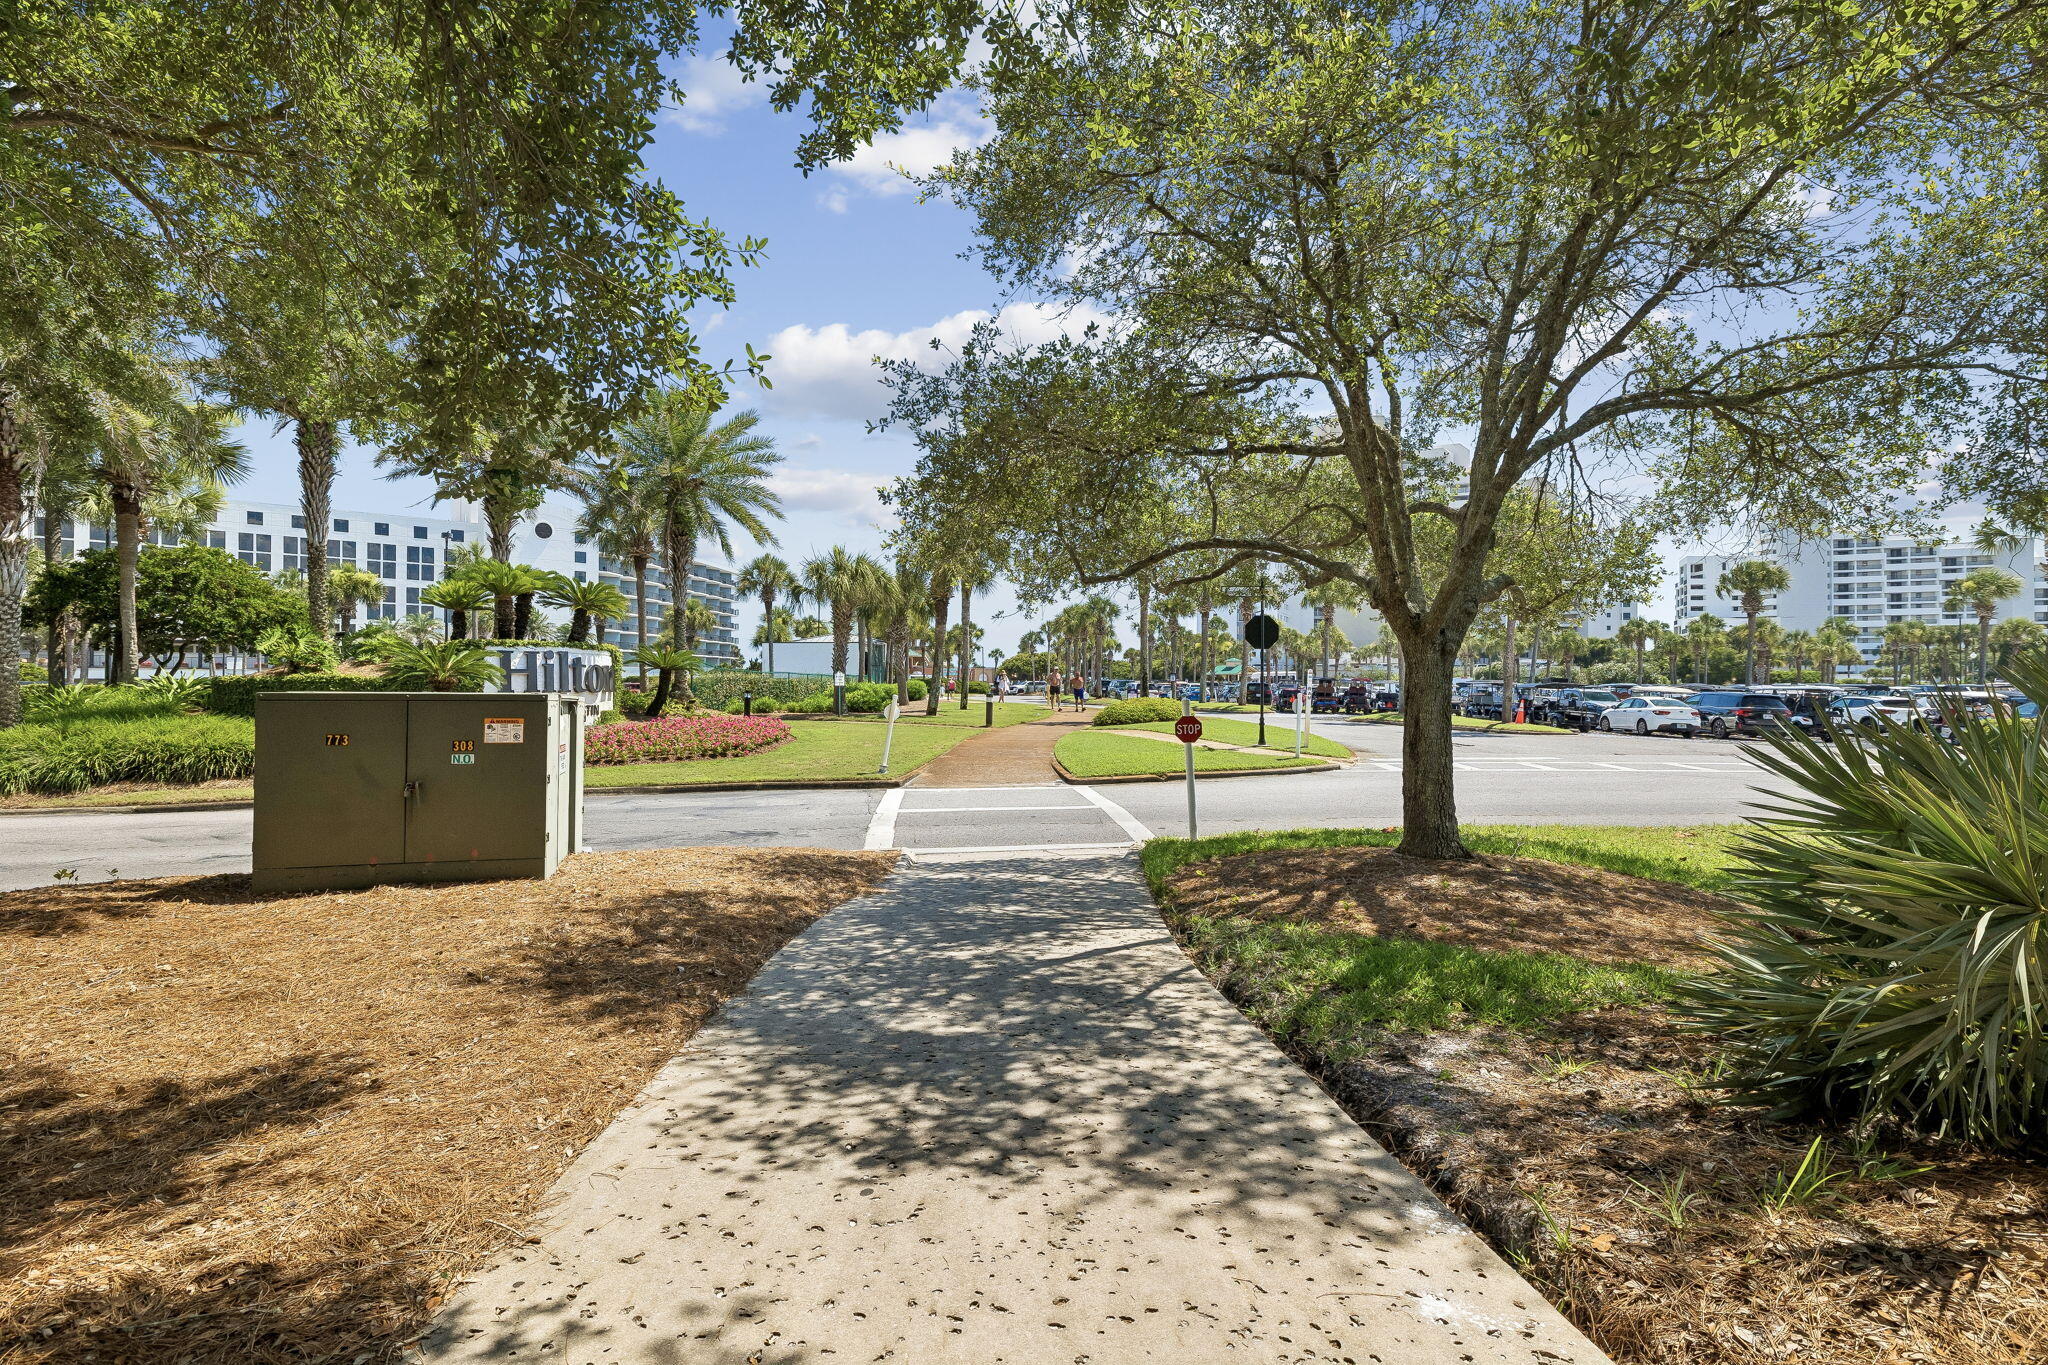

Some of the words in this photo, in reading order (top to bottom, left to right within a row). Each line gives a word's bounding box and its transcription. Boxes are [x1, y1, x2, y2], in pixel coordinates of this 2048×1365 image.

[497, 650, 616, 693] Hilton
[584, 705, 600, 717] TIN
[1176, 724, 1201, 735] STOP
[326, 734, 349, 746] 773
[452, 740, 474, 751] 308
[452, 754, 473, 764] N.O.
